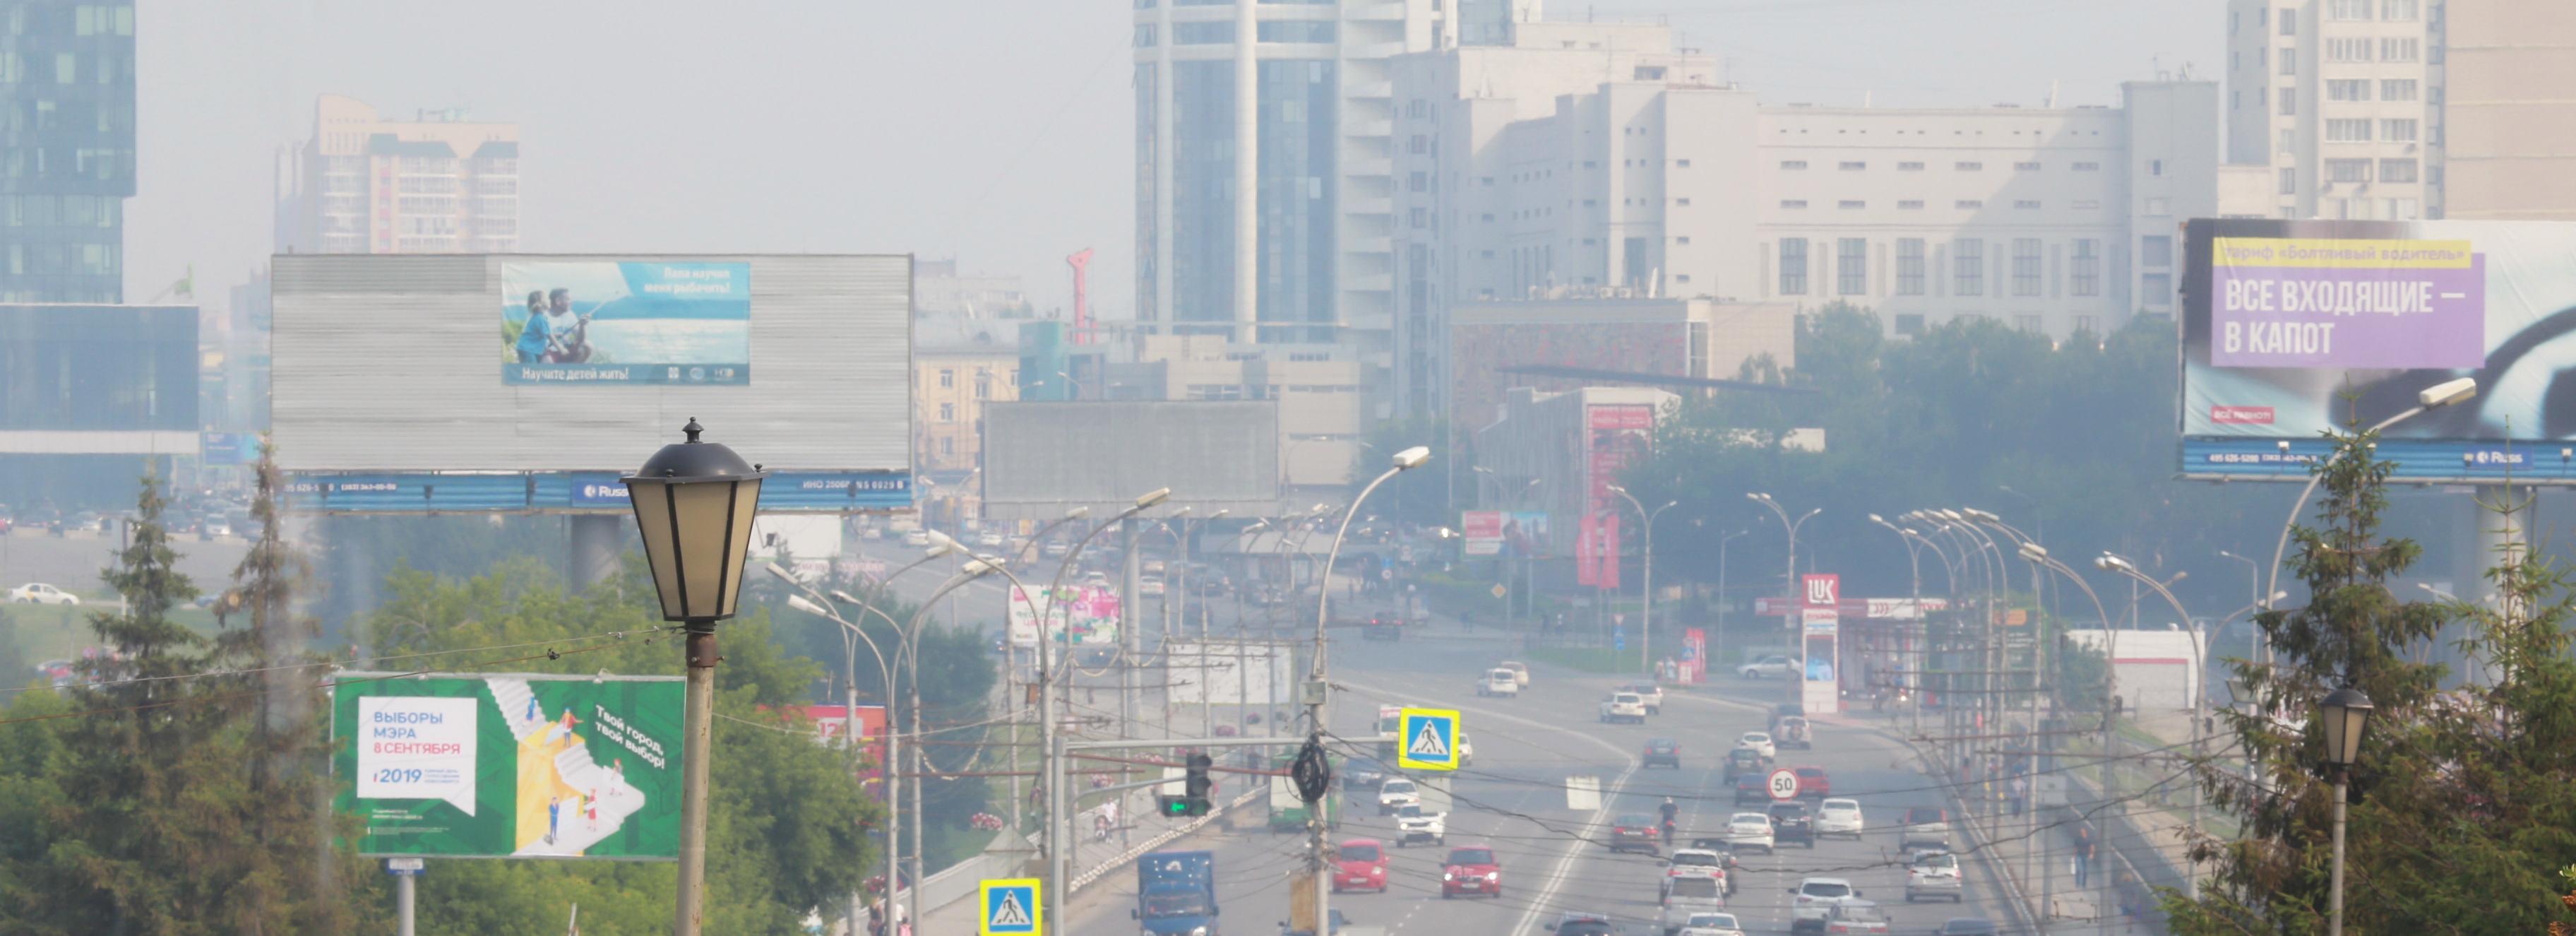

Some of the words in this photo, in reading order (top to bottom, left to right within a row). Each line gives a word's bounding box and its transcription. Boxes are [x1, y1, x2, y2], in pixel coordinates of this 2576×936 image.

[2225, 246, 2274, 261] тариф
[2225, 279, 2274, 312] ВСЕ
[2282, 280, 2434, 316] ВХОДЯЩИЕ
[2224, 321, 2242, 354] В
[2248, 321, 2335, 354] КАПОТ
[522, 367, 565, 382] Научите
[566, 367, 597, 381] детей
[599, 367, 628, 380] жить!
[2491, 451, 2523, 463] Russ
[374, 711, 443, 723] ВЫБОРЫ
[374, 726, 417, 738] МЭРА
[596, 704, 625, 731] Твой
[626, 725, 664, 757] город,
[374, 741, 382, 754] 8
[383, 742, 461, 754] СЕНТЯБРЯ
[595, 721, 624, 745] твой
[625, 738, 665, 769] выбор!
[379, 768, 422, 783] 2019
[1775, 778, 1793, 792] 50
